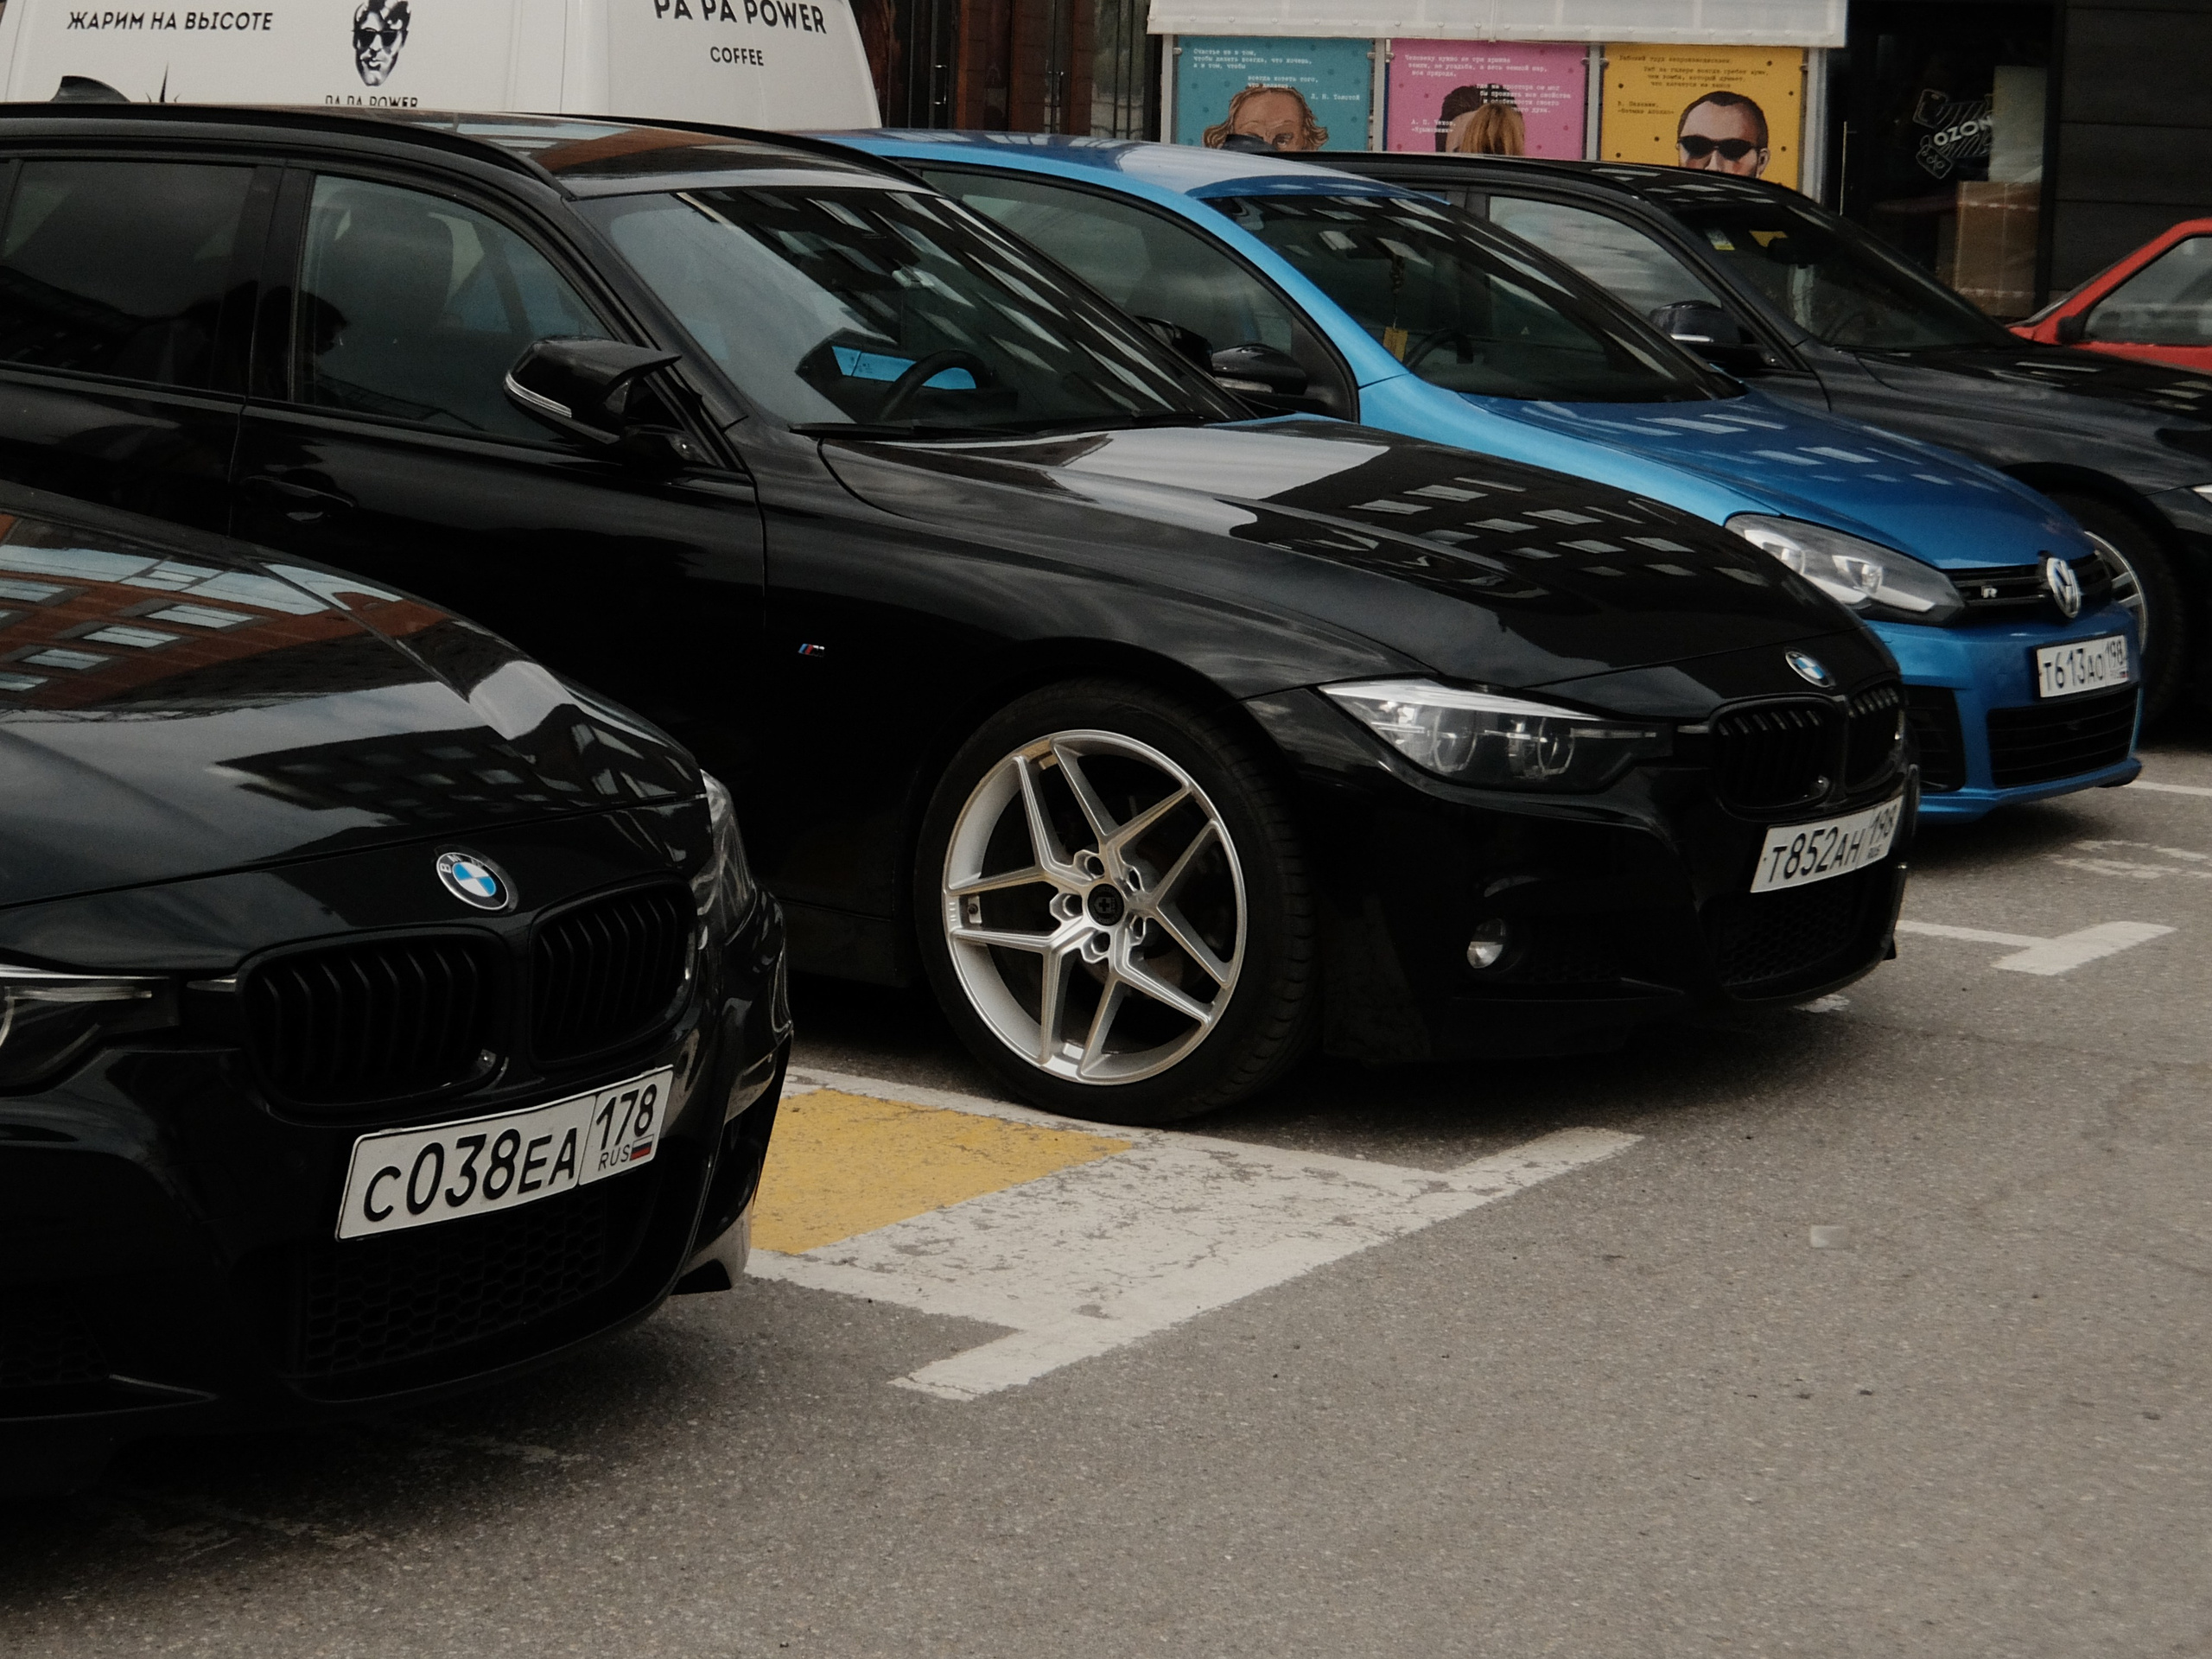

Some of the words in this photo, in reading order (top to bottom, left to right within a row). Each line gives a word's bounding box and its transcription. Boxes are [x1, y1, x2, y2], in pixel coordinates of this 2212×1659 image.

[67, 10, 144, 30] ЖАРИМ
[150, 11, 178, 30] НА
[184, 11, 273, 31] ВЫСОТЕ
[654, 0, 694, 19] PA
[702, 0, 737, 22] PA
[744, 0, 827, 34] POWER
[710, 46, 765, 67] COFFEE
[1933, 115, 1993, 146] OZON
[596, 1083, 658, 1151] 178
[597, 1143, 632, 1172] RUS
